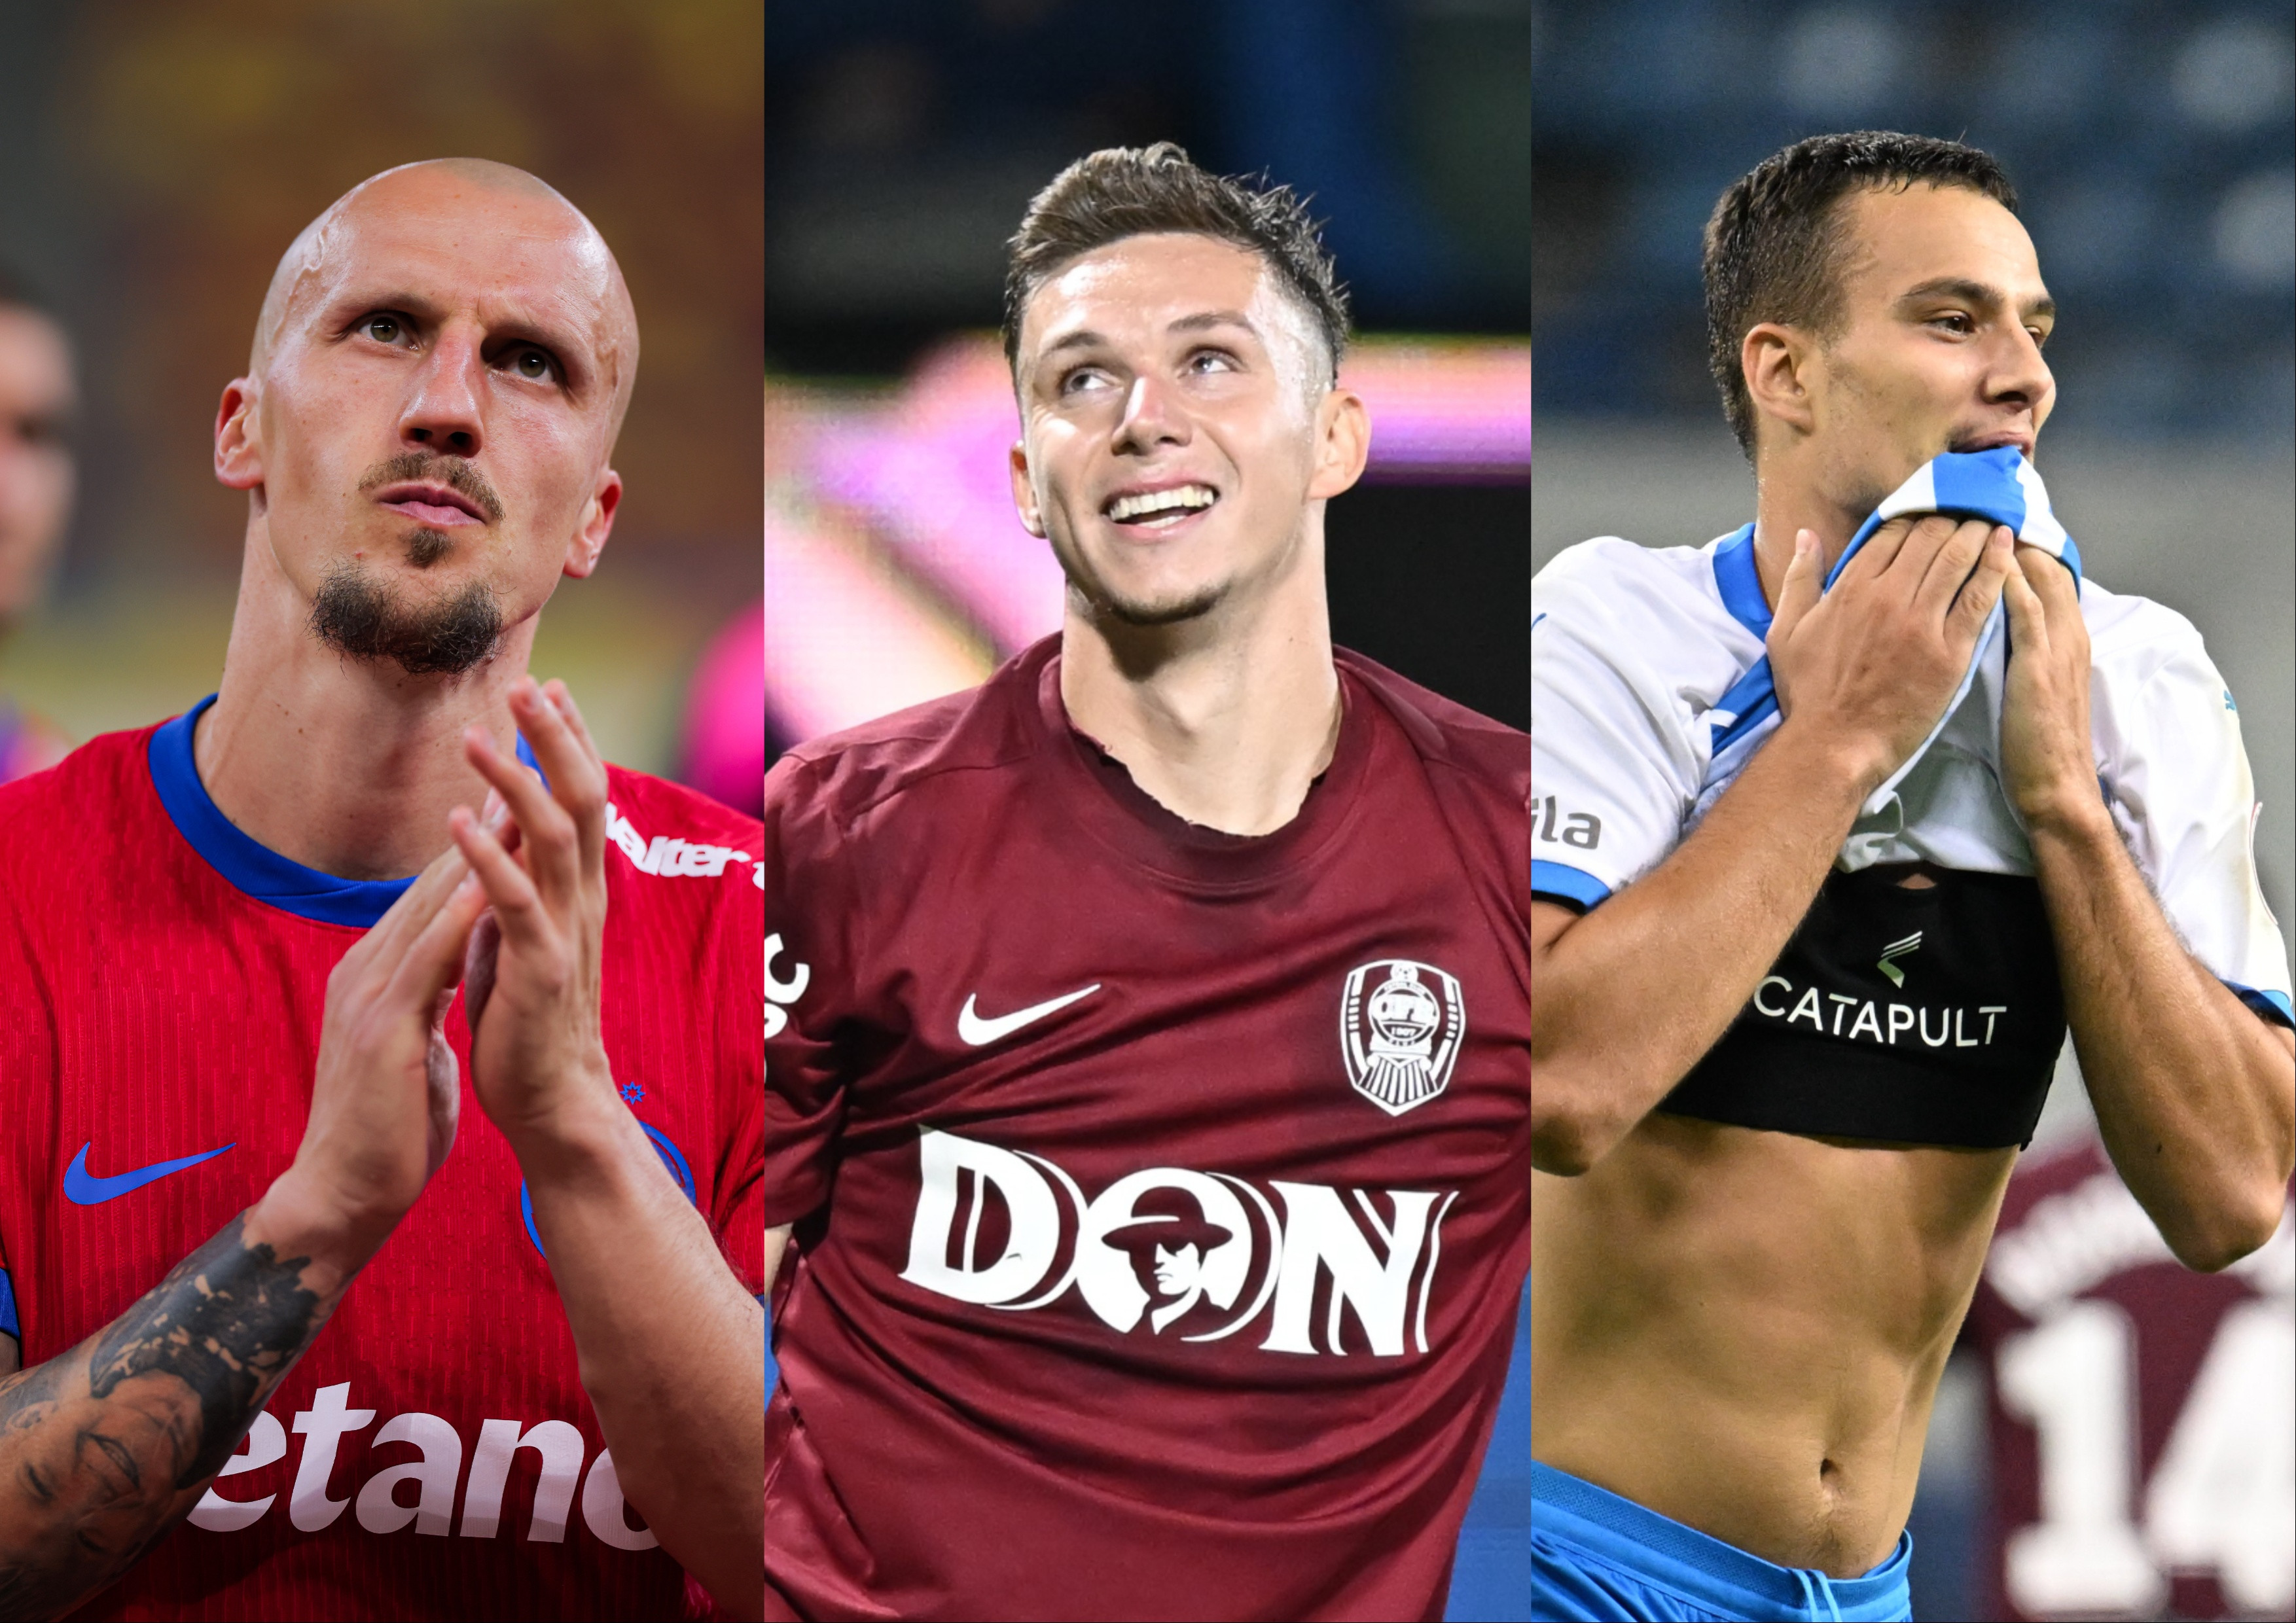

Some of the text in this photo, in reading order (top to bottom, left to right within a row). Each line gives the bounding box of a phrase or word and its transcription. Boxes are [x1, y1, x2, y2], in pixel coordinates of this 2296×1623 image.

[1753, 976, 2007, 1047] CATAPULT
[897, 1124, 1460, 1357] DON
[1994, 1298, 2295, 1614] 14
